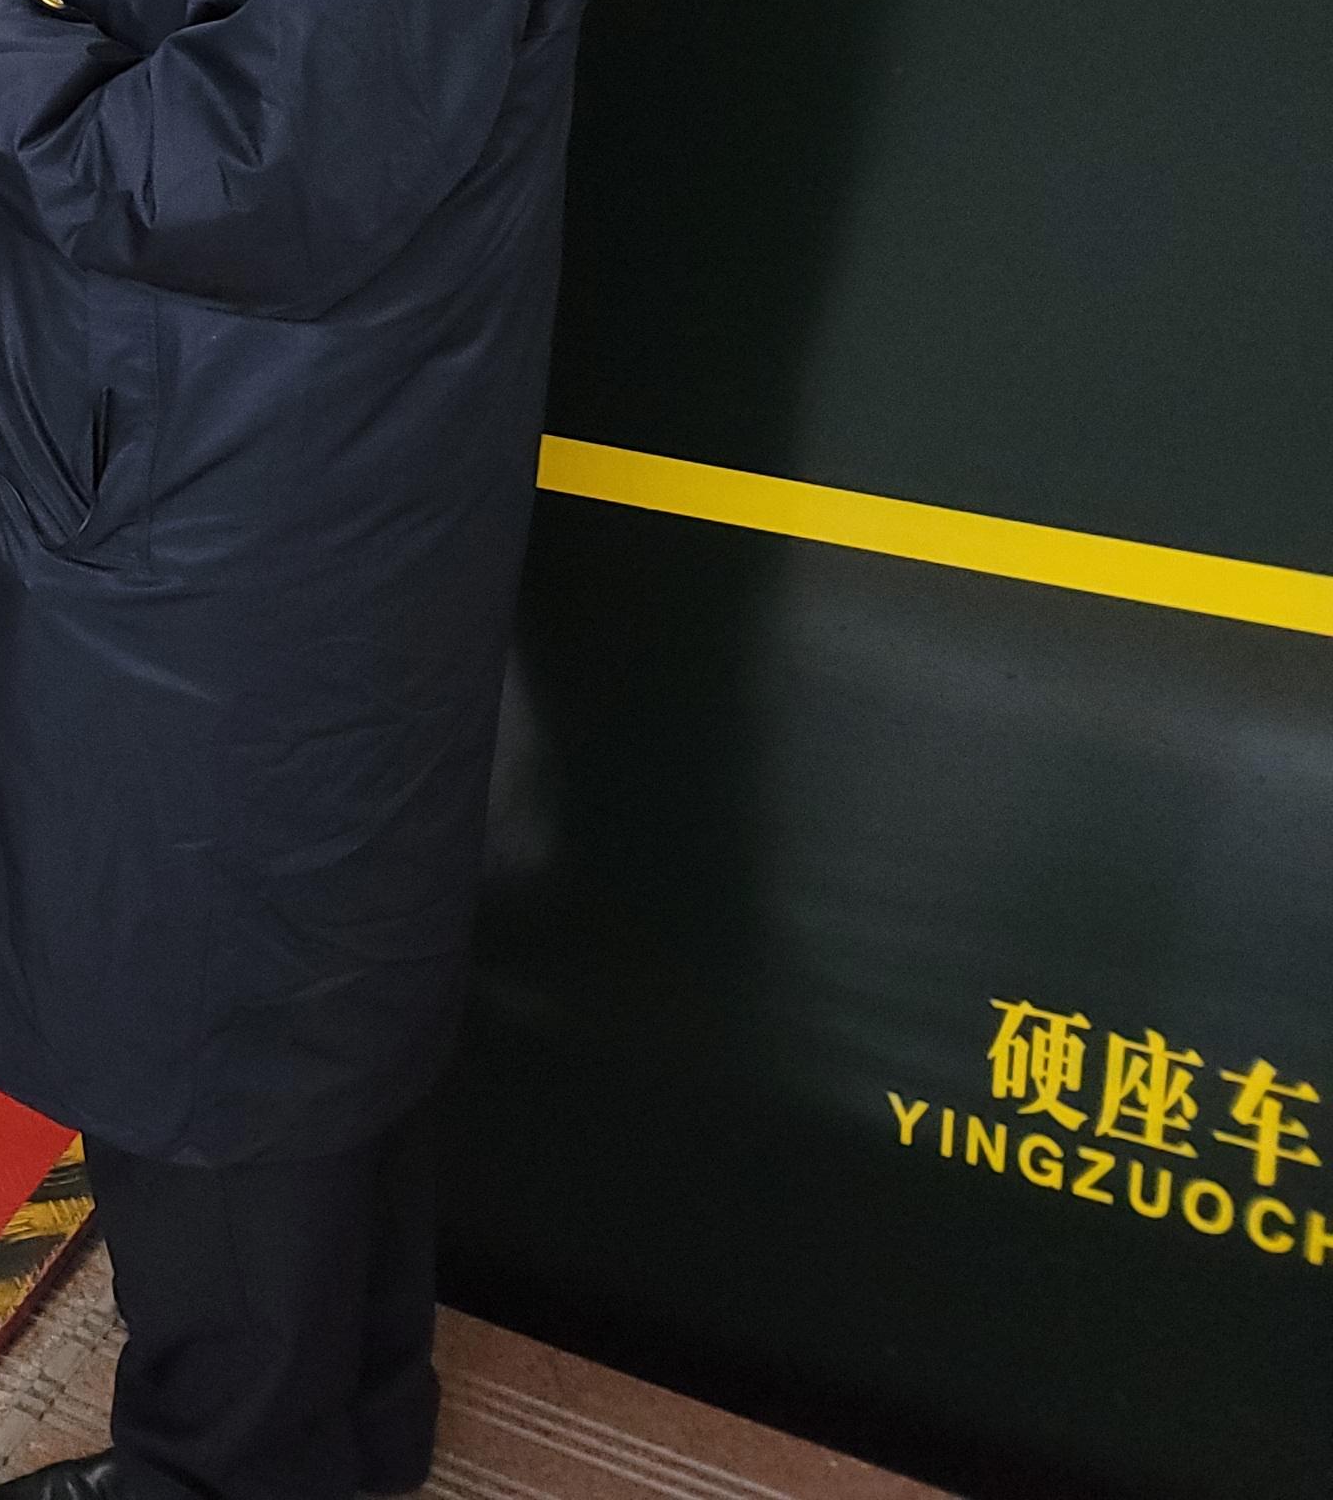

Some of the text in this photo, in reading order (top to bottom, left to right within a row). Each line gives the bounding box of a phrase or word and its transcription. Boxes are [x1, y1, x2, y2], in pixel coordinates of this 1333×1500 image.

[886, 1090, 1333, 1267] YINGZUOCH
[985, 997, 1323, 1188] 硬座车
